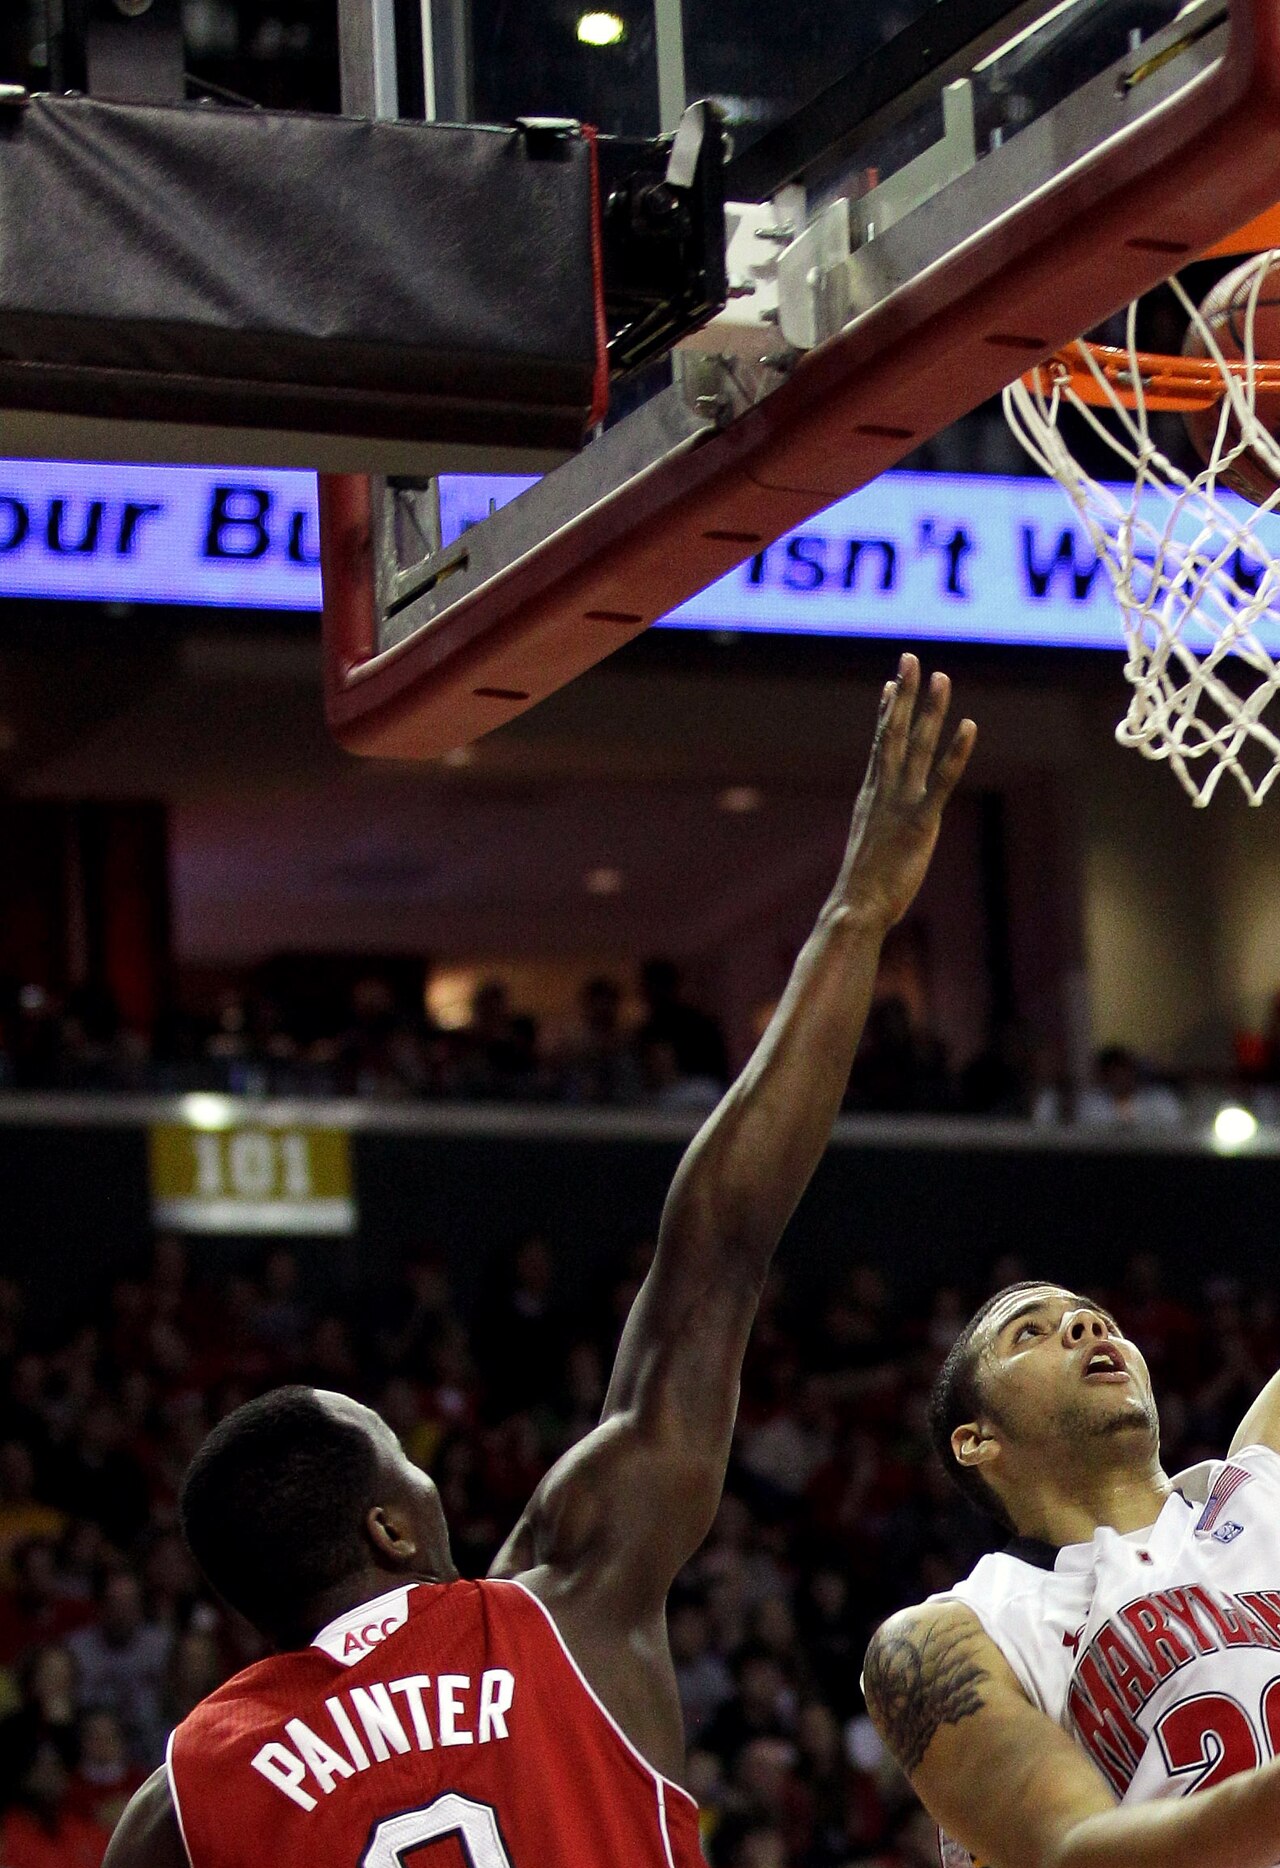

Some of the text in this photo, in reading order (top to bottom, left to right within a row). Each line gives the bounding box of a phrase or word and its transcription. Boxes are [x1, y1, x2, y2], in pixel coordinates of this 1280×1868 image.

[194, 1131, 308, 1194] 101
[342, 1616, 399, 1657] ACC
[250, 1667, 515, 1813] PAINTER
